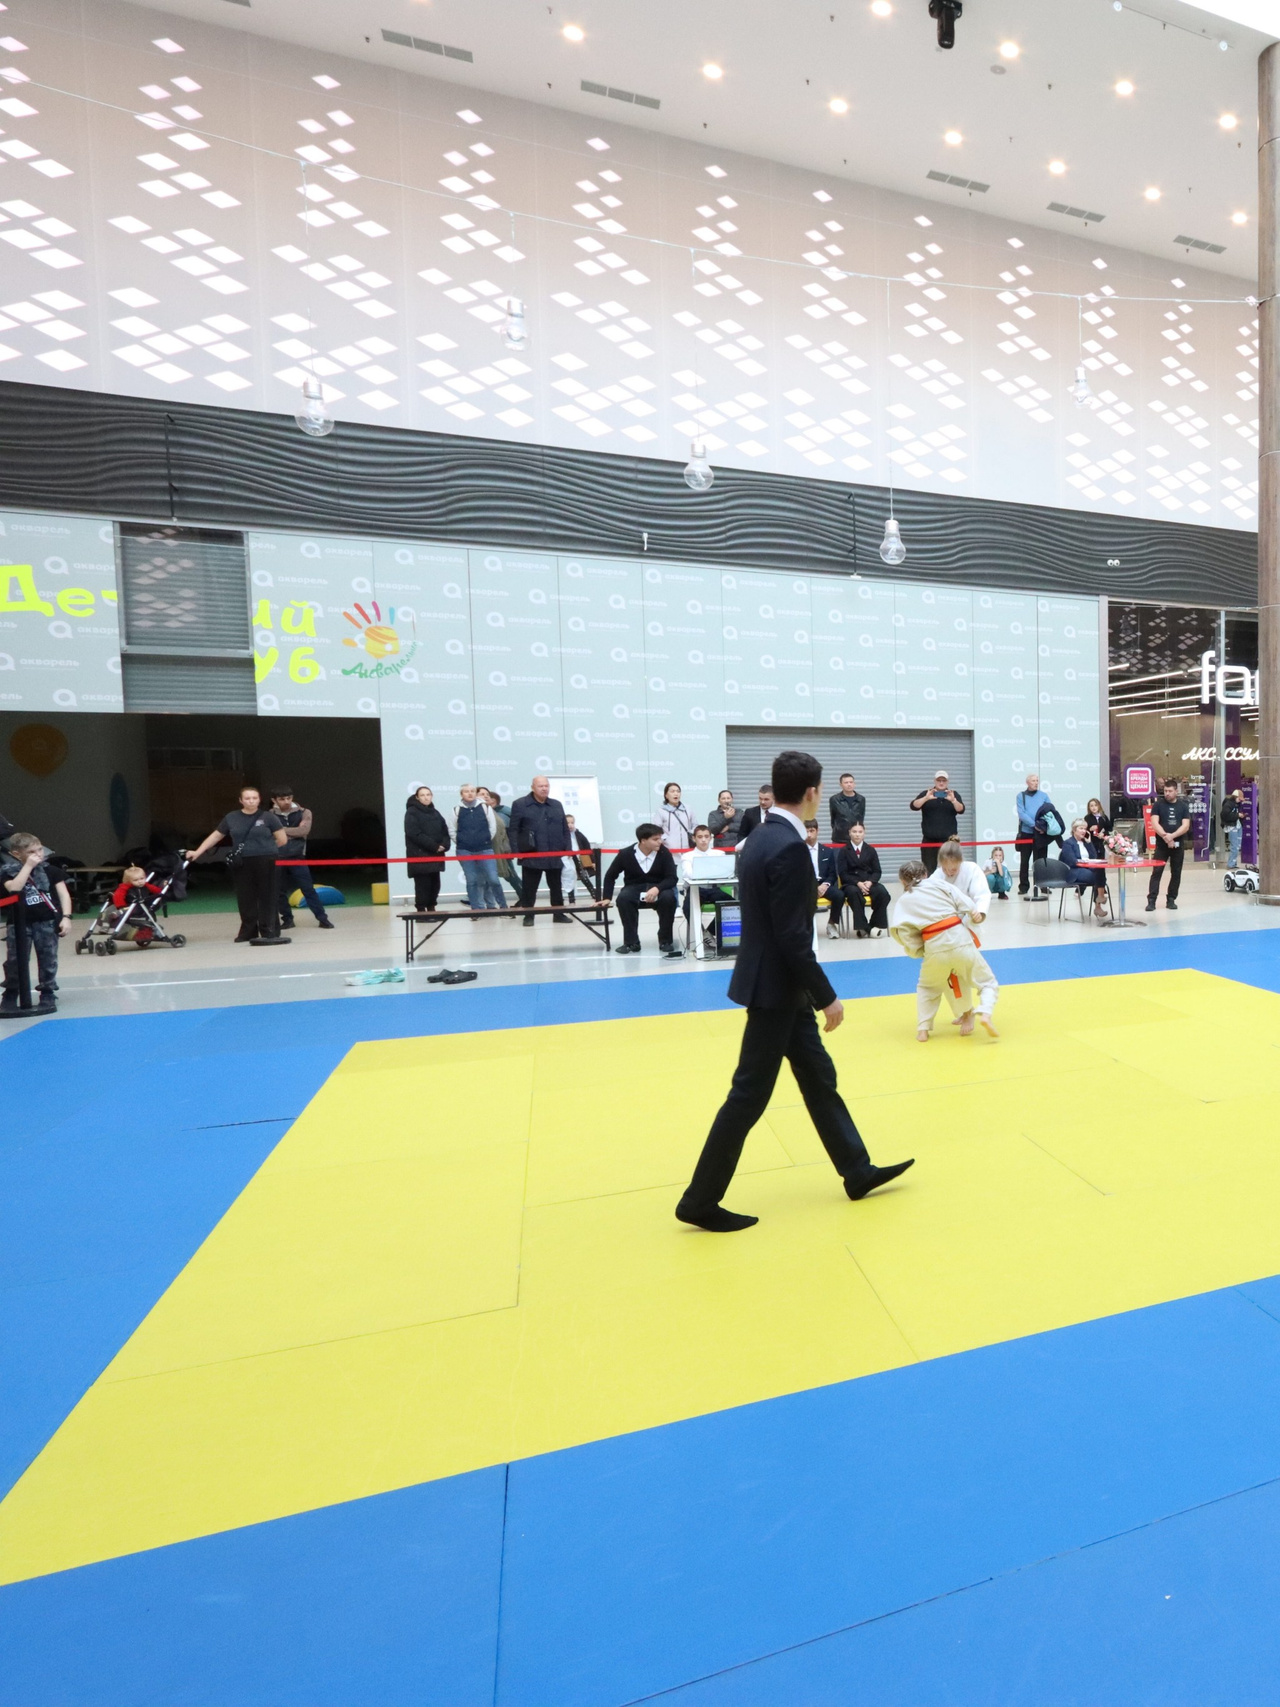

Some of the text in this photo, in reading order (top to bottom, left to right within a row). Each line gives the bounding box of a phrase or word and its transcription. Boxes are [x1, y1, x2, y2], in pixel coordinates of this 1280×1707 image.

[10, 523, 71, 535] акварель
[19, 658, 80, 668] акварель
[283, 698, 335, 707] акварель
